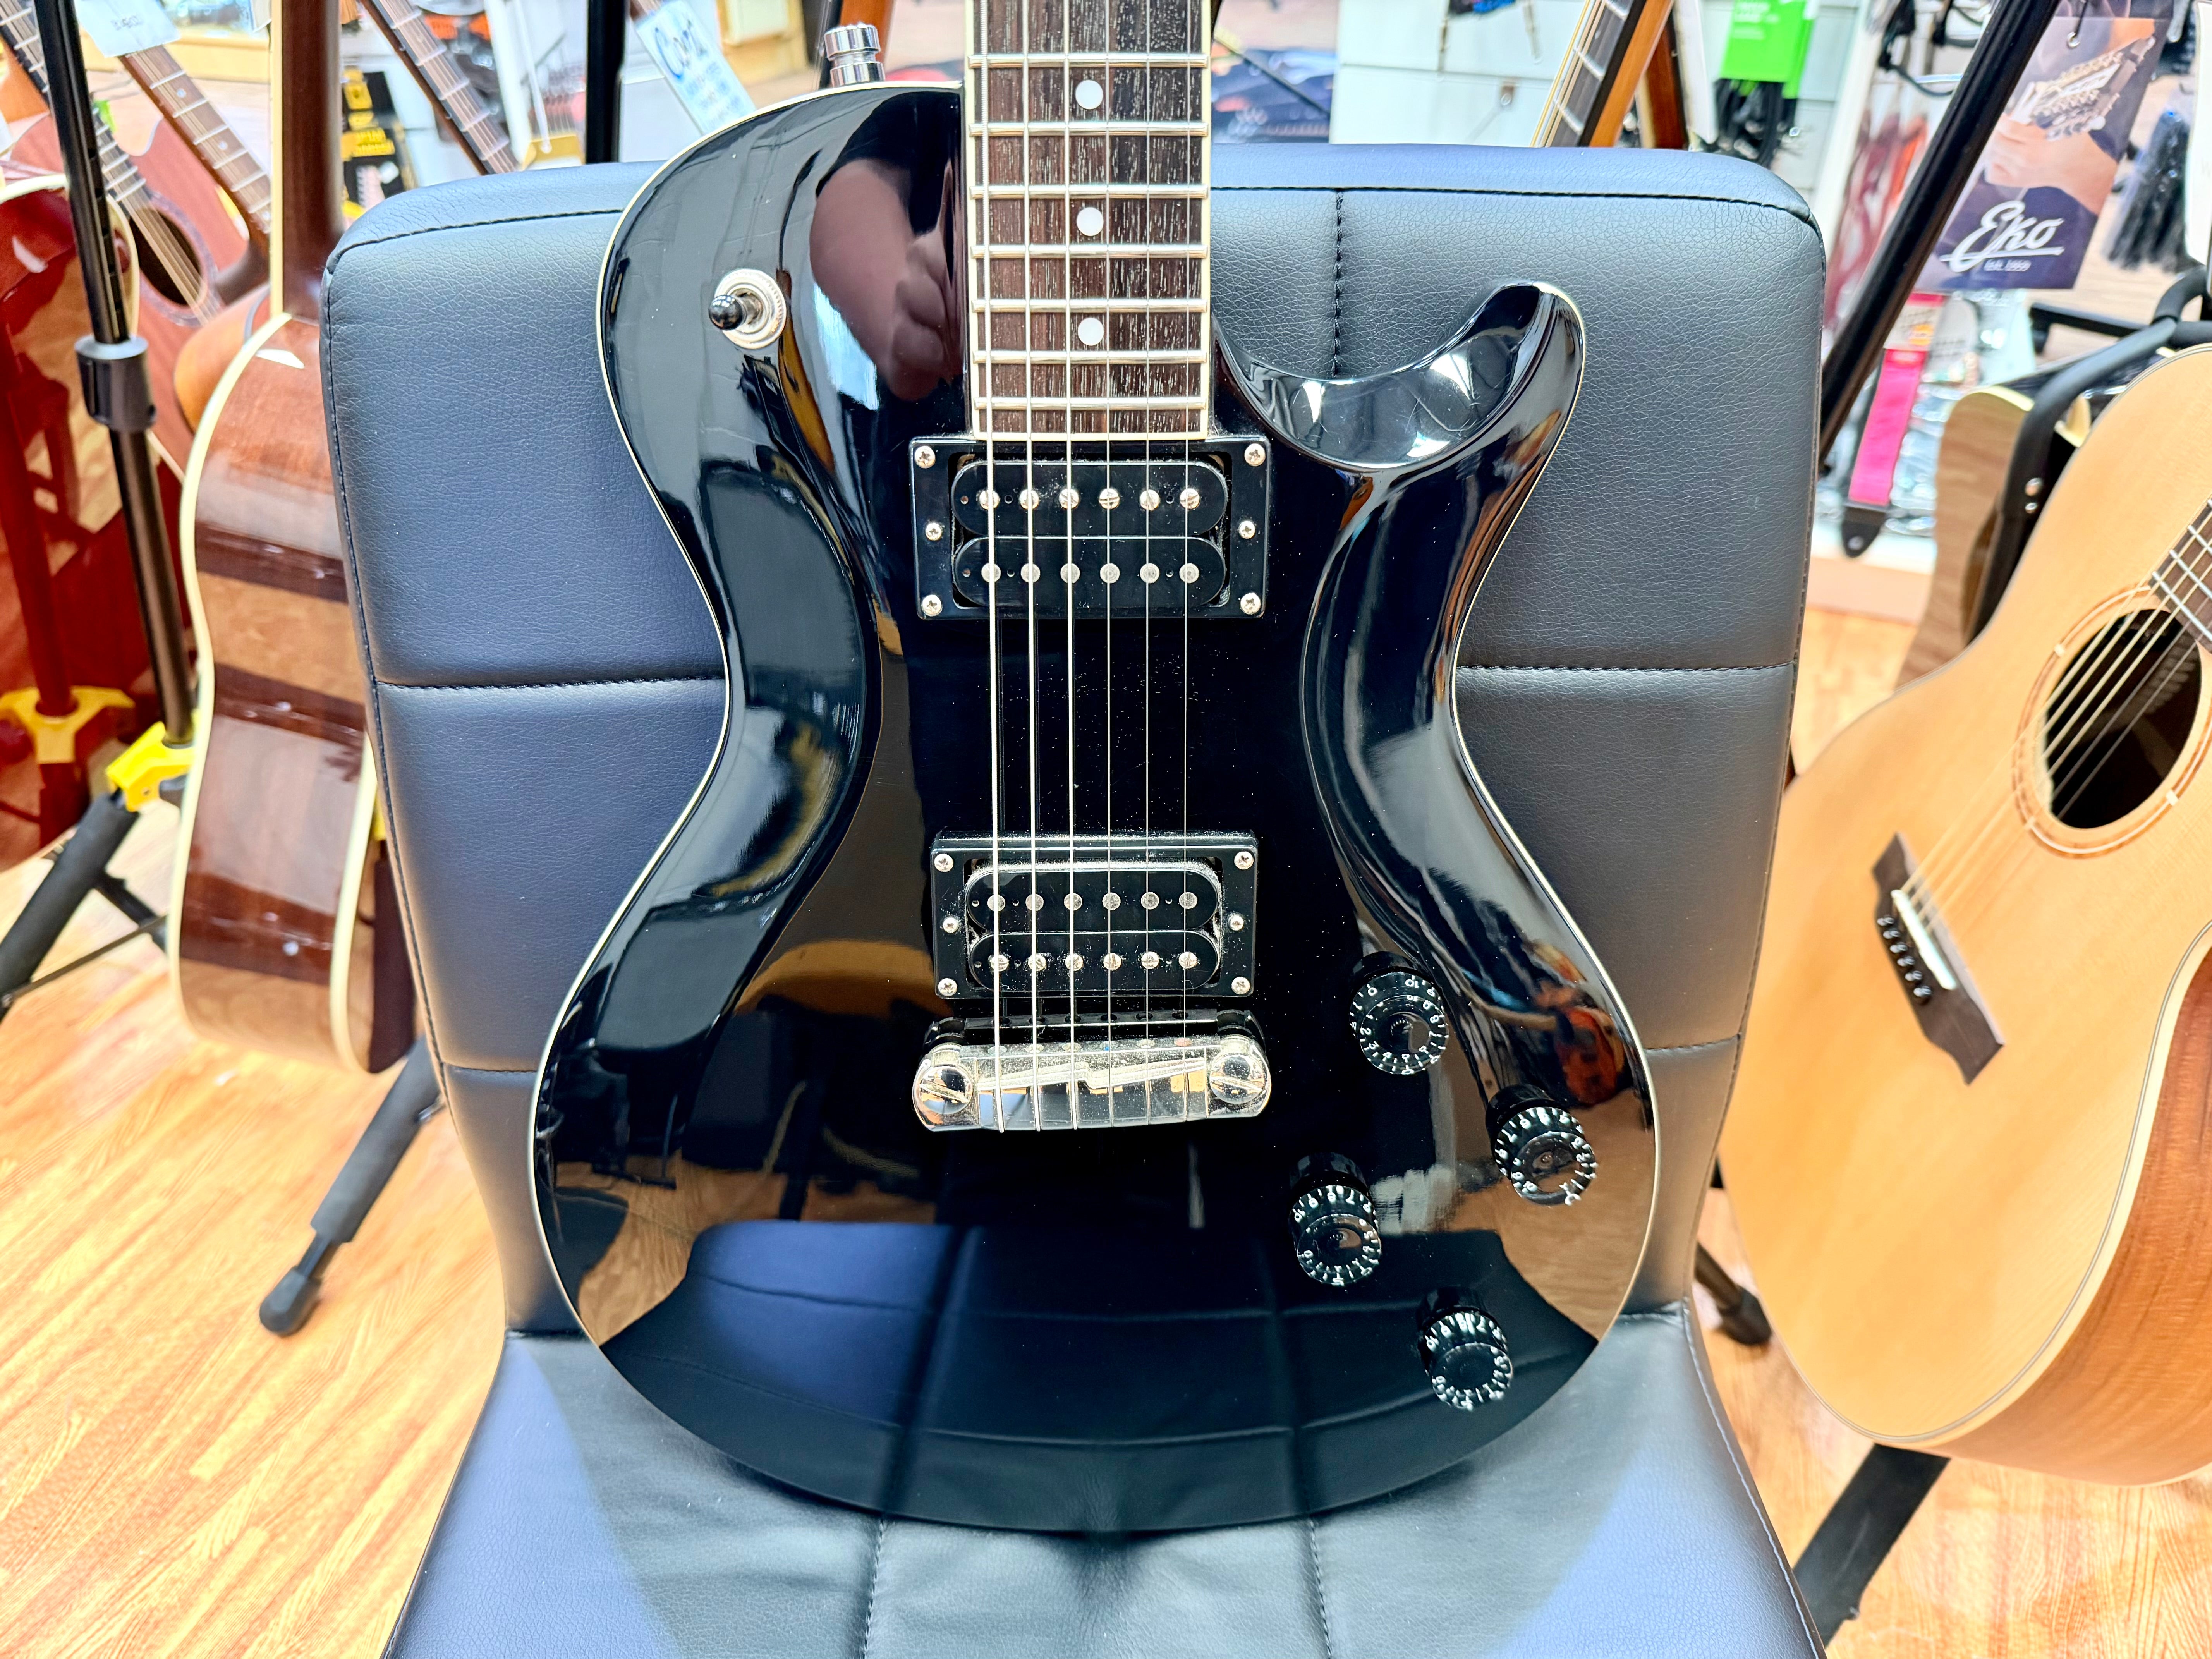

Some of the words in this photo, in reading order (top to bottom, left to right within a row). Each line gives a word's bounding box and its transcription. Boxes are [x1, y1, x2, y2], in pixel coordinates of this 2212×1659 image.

[1949, 200, 2065, 273] Eko
[1405, 979, 1420, 989] 10
[1430, 1014, 1439, 1024] 8
[1368, 1041, 1380, 1050] 3
